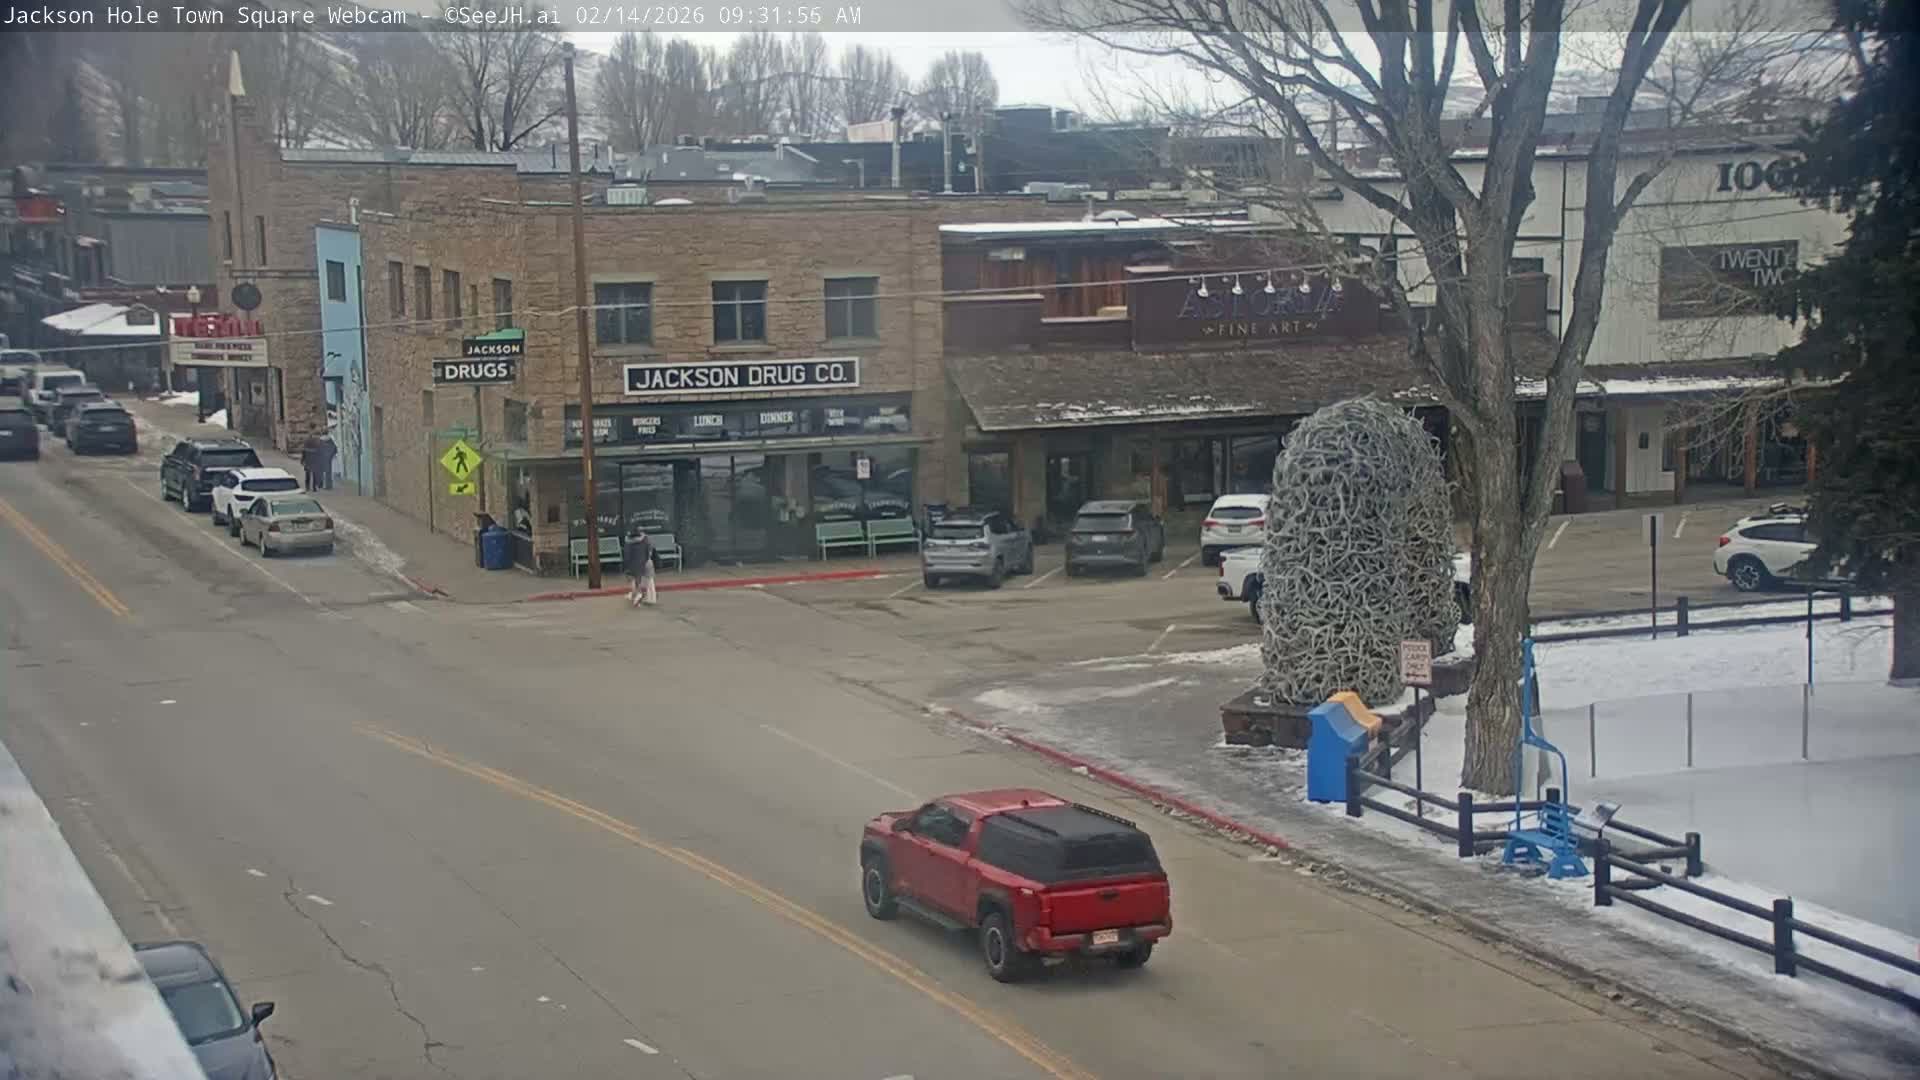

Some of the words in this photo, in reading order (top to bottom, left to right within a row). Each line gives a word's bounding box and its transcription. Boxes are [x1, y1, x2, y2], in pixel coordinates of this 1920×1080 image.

[1218, 322, 1257, 337] FINE
[1269, 320, 1301, 335] ART
[466, 344, 520, 355] JACKSON
[444, 362, 508, 380] DRUGS
[636, 366, 739, 389] JACKSON
[748, 365, 807, 386] DRUG
[815, 363, 848, 383] CO.
[693, 414, 723, 428] LUNCH
[760, 411, 793, 425] DINNER
